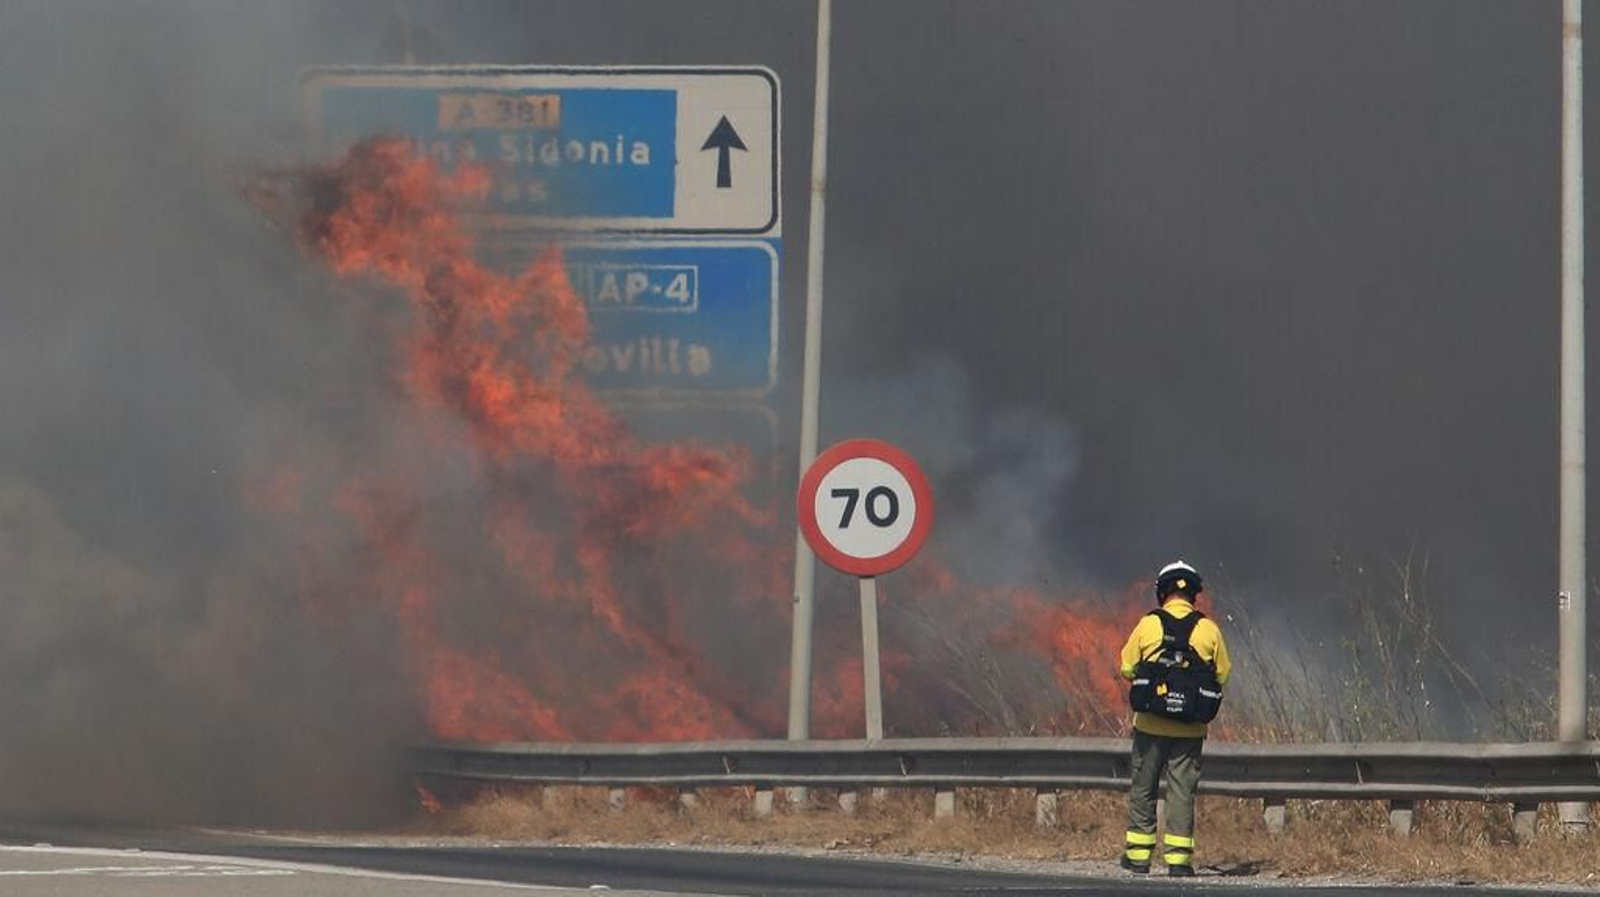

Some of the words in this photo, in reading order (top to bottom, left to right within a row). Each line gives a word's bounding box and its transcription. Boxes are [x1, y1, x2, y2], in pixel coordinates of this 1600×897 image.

[500, 133, 651, 167] Sidonia
[599, 271, 690, 303] AP-4
[582, 337, 712, 376] evilla
[830, 485, 900, 529] 70
